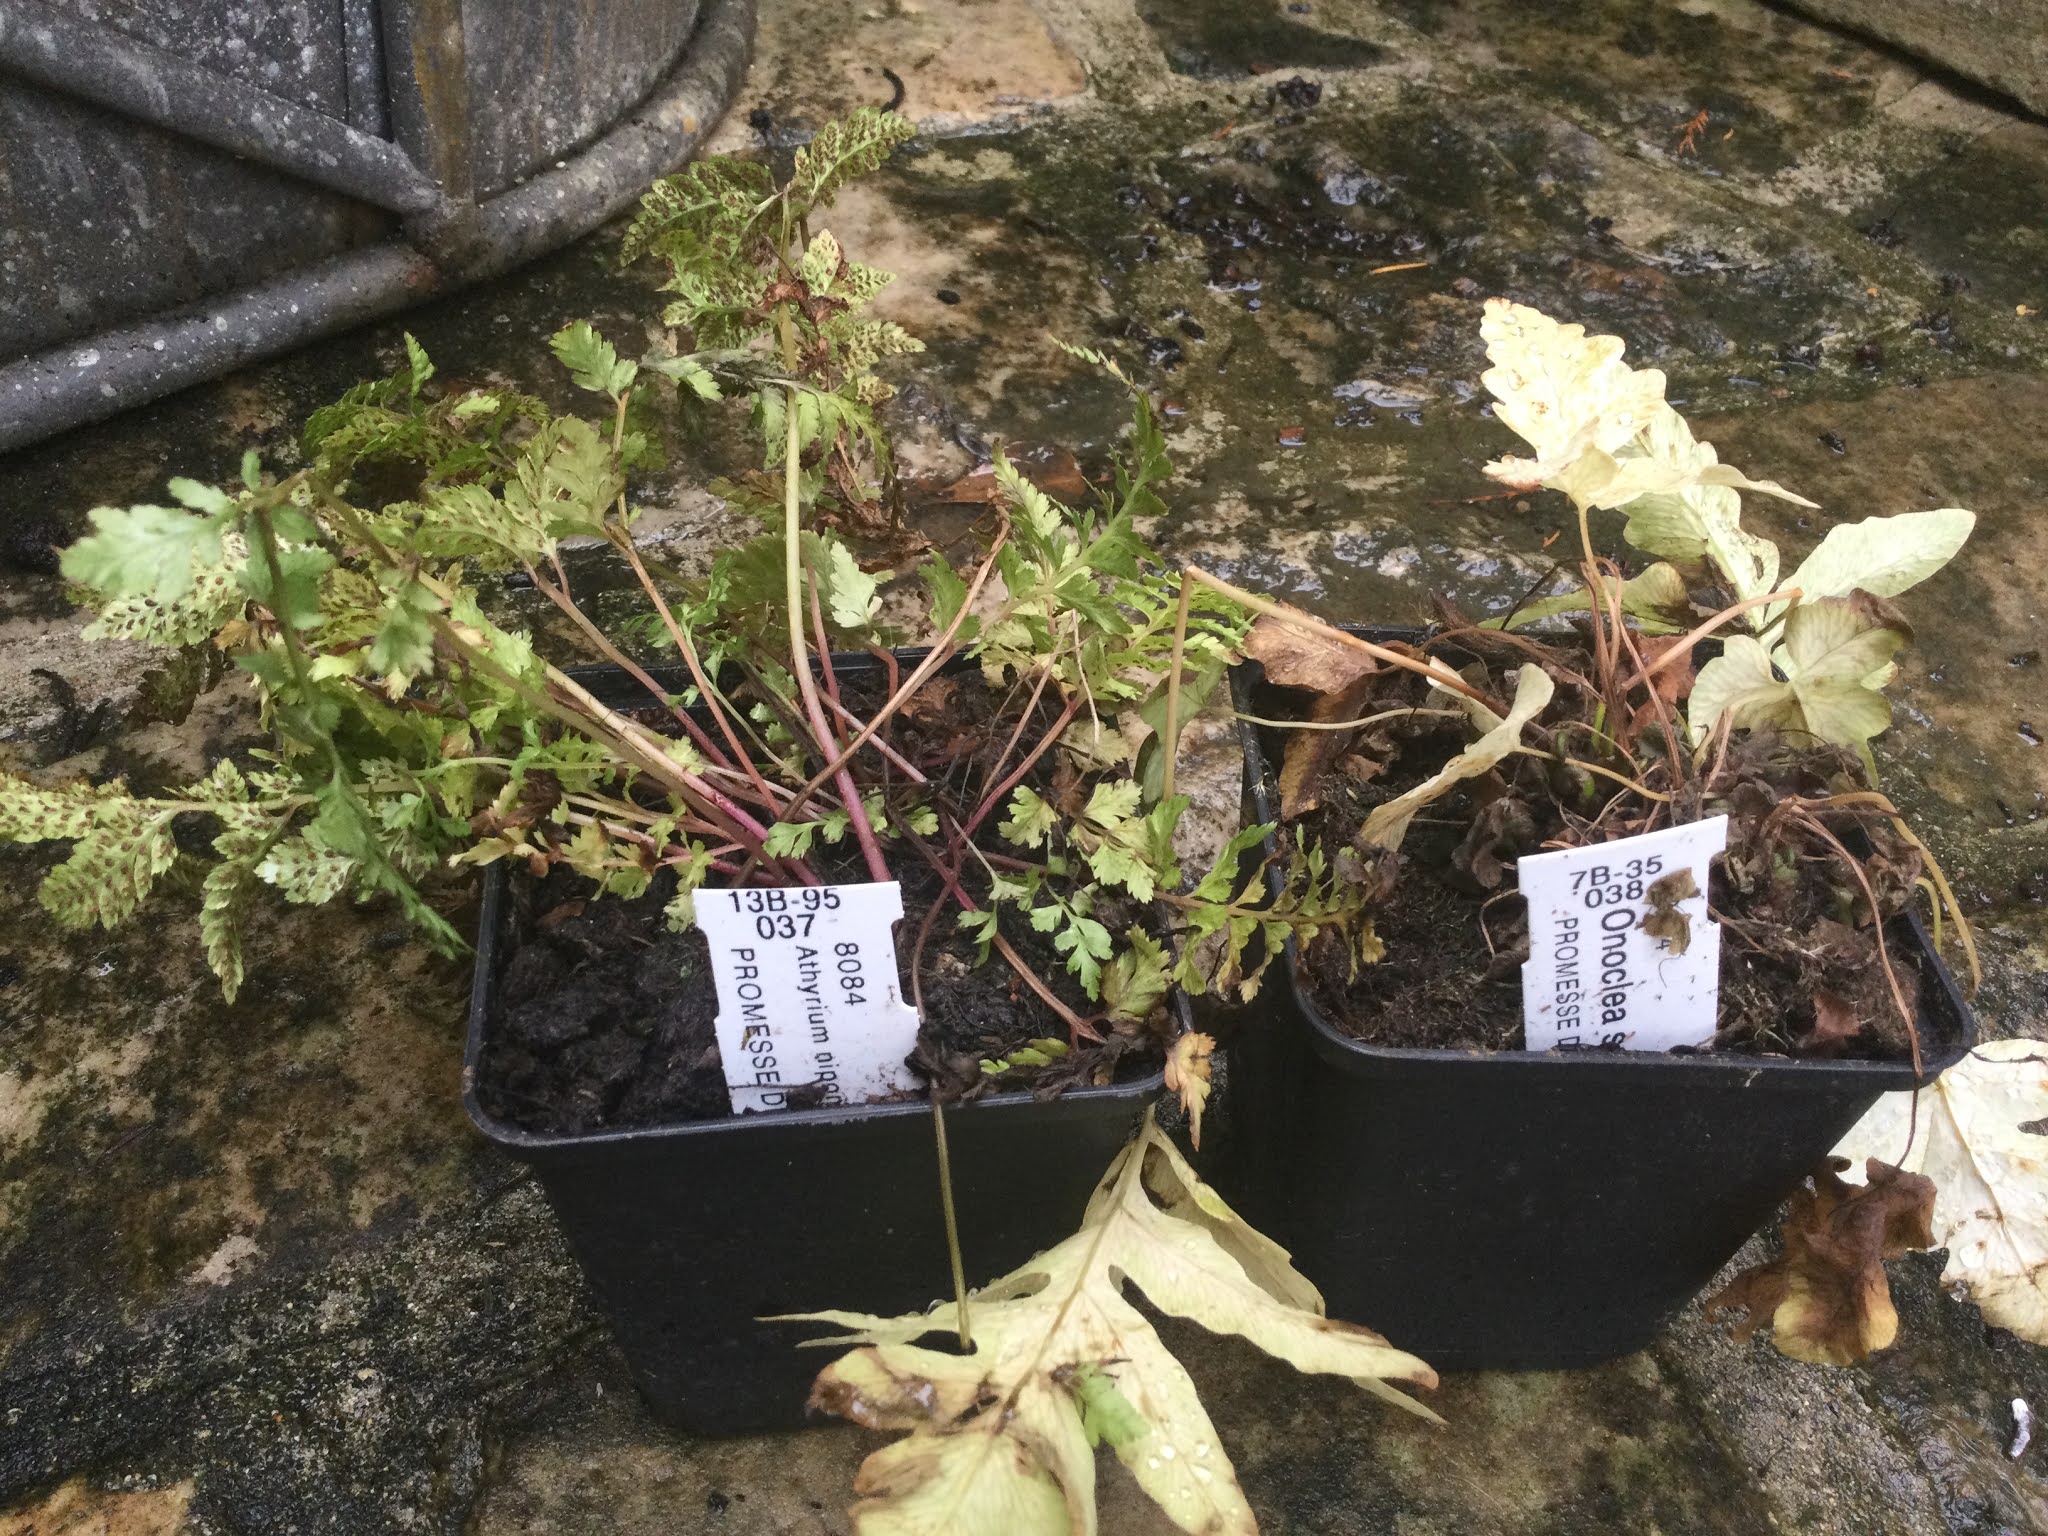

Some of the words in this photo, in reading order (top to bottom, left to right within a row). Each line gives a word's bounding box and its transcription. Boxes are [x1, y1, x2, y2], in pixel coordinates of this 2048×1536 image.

[728, 887, 841, 913] 13B-95
[1569, 855, 1663, 890] 7B-35
[1584, 880, 1644, 908] 038
[756, 913, 816, 940] 037
[795, 945, 829, 1043] Athyrium
[834, 942, 867, 1006] 8084
[1554, 917, 1580, 1031] PROMESSE
[1601, 908, 1636, 1025] Onoclea
[730, 948, 781, 1087] PROMESSE
